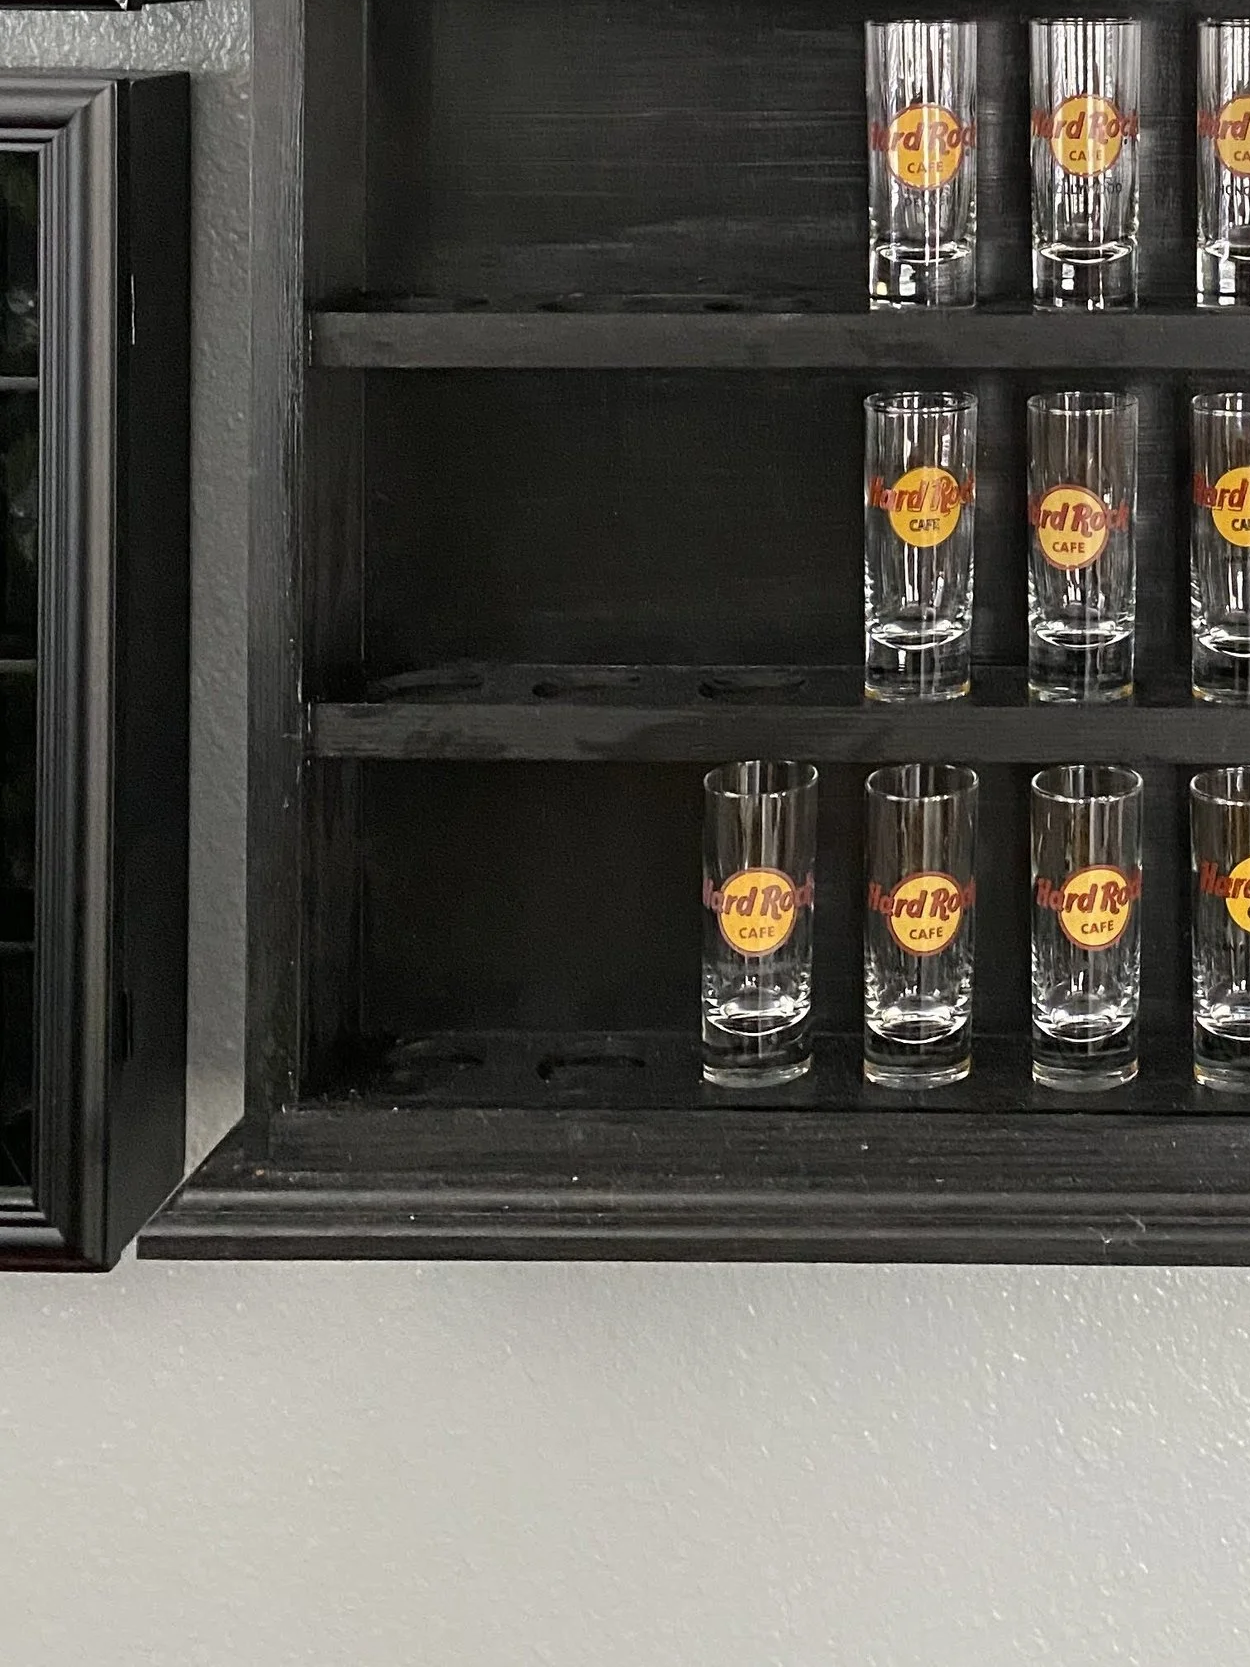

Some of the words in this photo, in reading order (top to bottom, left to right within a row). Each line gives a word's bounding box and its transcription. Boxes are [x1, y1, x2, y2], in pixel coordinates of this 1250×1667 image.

[1069, 150, 1104, 162] CAE
[907, 162, 943, 174] CAFE
[909, 518, 940, 532] CAFE
[1052, 541, 1085, 553] CAFE
[739, 926, 775, 939] CAFE
[909, 926, 943, 940] CAFE
[1081, 920, 1114, 935] CAFE
